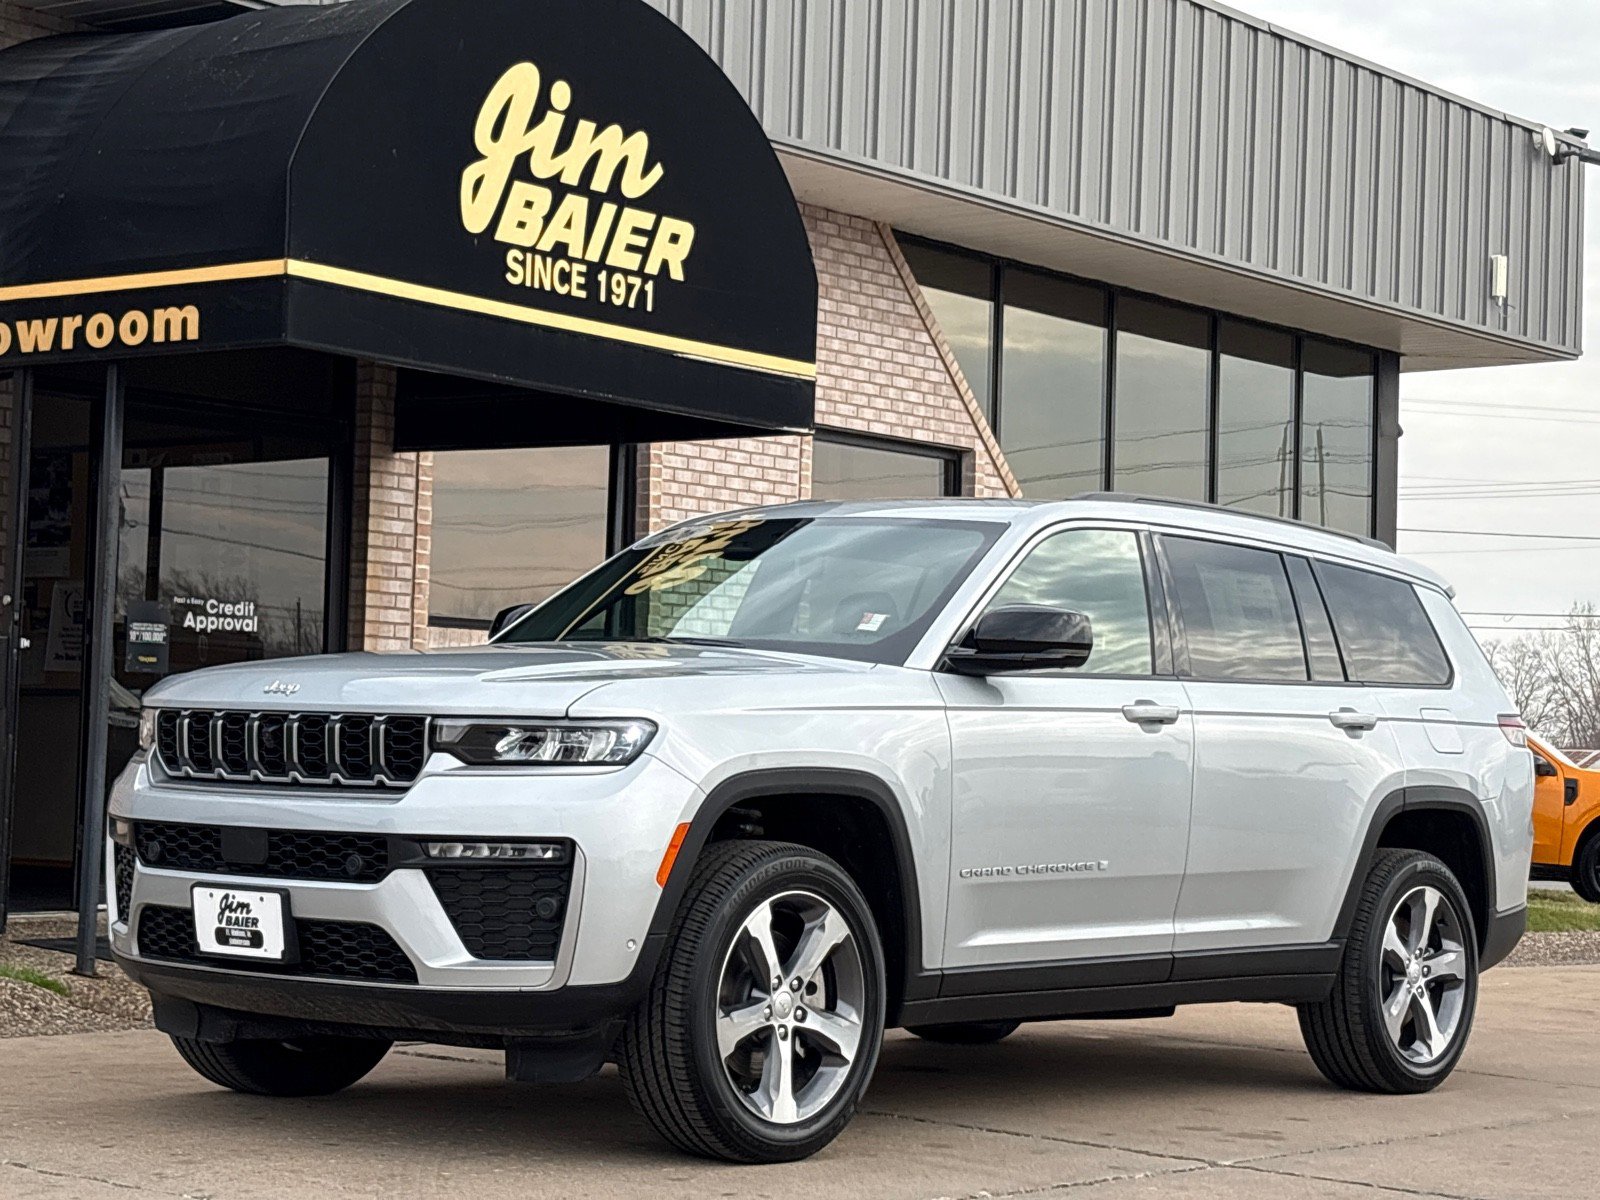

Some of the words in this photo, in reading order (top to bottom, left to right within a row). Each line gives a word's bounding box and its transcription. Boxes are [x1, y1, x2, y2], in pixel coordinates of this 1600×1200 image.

[461, 61, 665, 234] Jim
[494, 180, 695, 282] BAIER
[505, 248, 588, 299] SINCE
[597, 269, 654, 312] 1971
[205, 598, 255, 617] Credit
[182, 611, 258, 633] Approval
[263, 680, 301, 696] Jeep
[959, 866, 1014, 878] GRAND
[1015, 861, 1096, 875] CHEROKEE
[217, 892, 252, 925] Jim
[225, 915, 260, 928] BAIER
